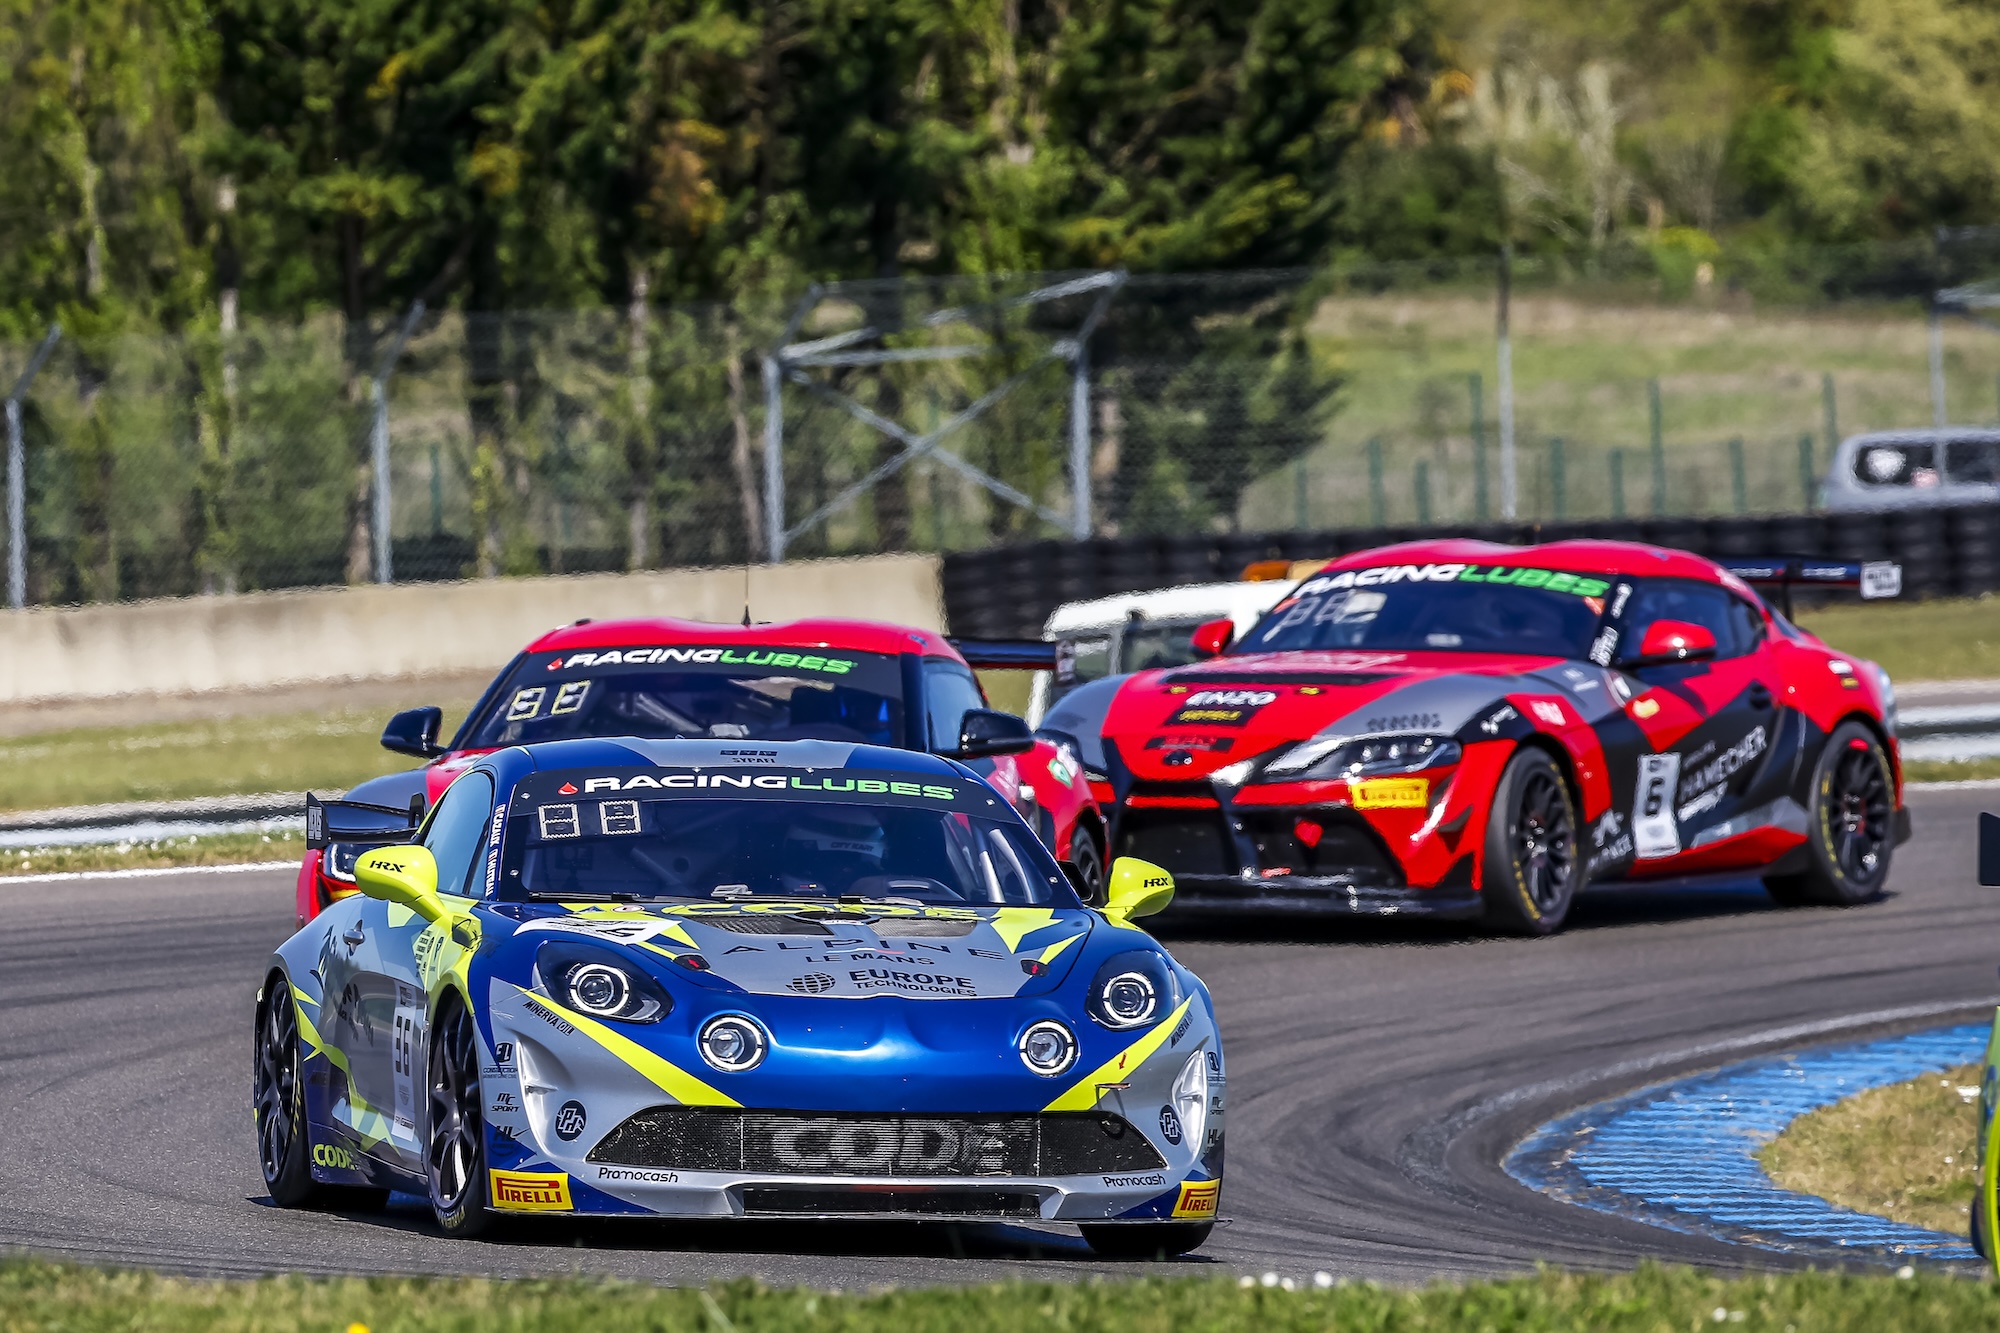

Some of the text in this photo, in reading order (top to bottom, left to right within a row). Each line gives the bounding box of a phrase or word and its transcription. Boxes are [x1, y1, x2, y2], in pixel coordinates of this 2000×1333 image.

[563, 648, 857, 675] RACINGLUBES
[584, 774, 956, 801] RACINGLUBES
[489, 813, 505, 848] CAZAUX
[369, 860, 407, 873] HRX
[1143, 877, 1169, 888] HRX
[721, 939, 1006, 960] ALPINE
[805, 952, 936, 966] LE MANS
[848, 968, 977, 989] EUROPE
[853, 981, 978, 998] TECHNOLOGIES
[522, 999, 575, 1037] MINERVA OIL
[490, 1105, 521, 1113] SPORT
[771, 1116, 1005, 1171] CODE
[598, 1167, 679, 1183] Promocash
[1102, 1172, 1166, 1187] Promocash
[495, 1176, 563, 1204] PIRELLI
